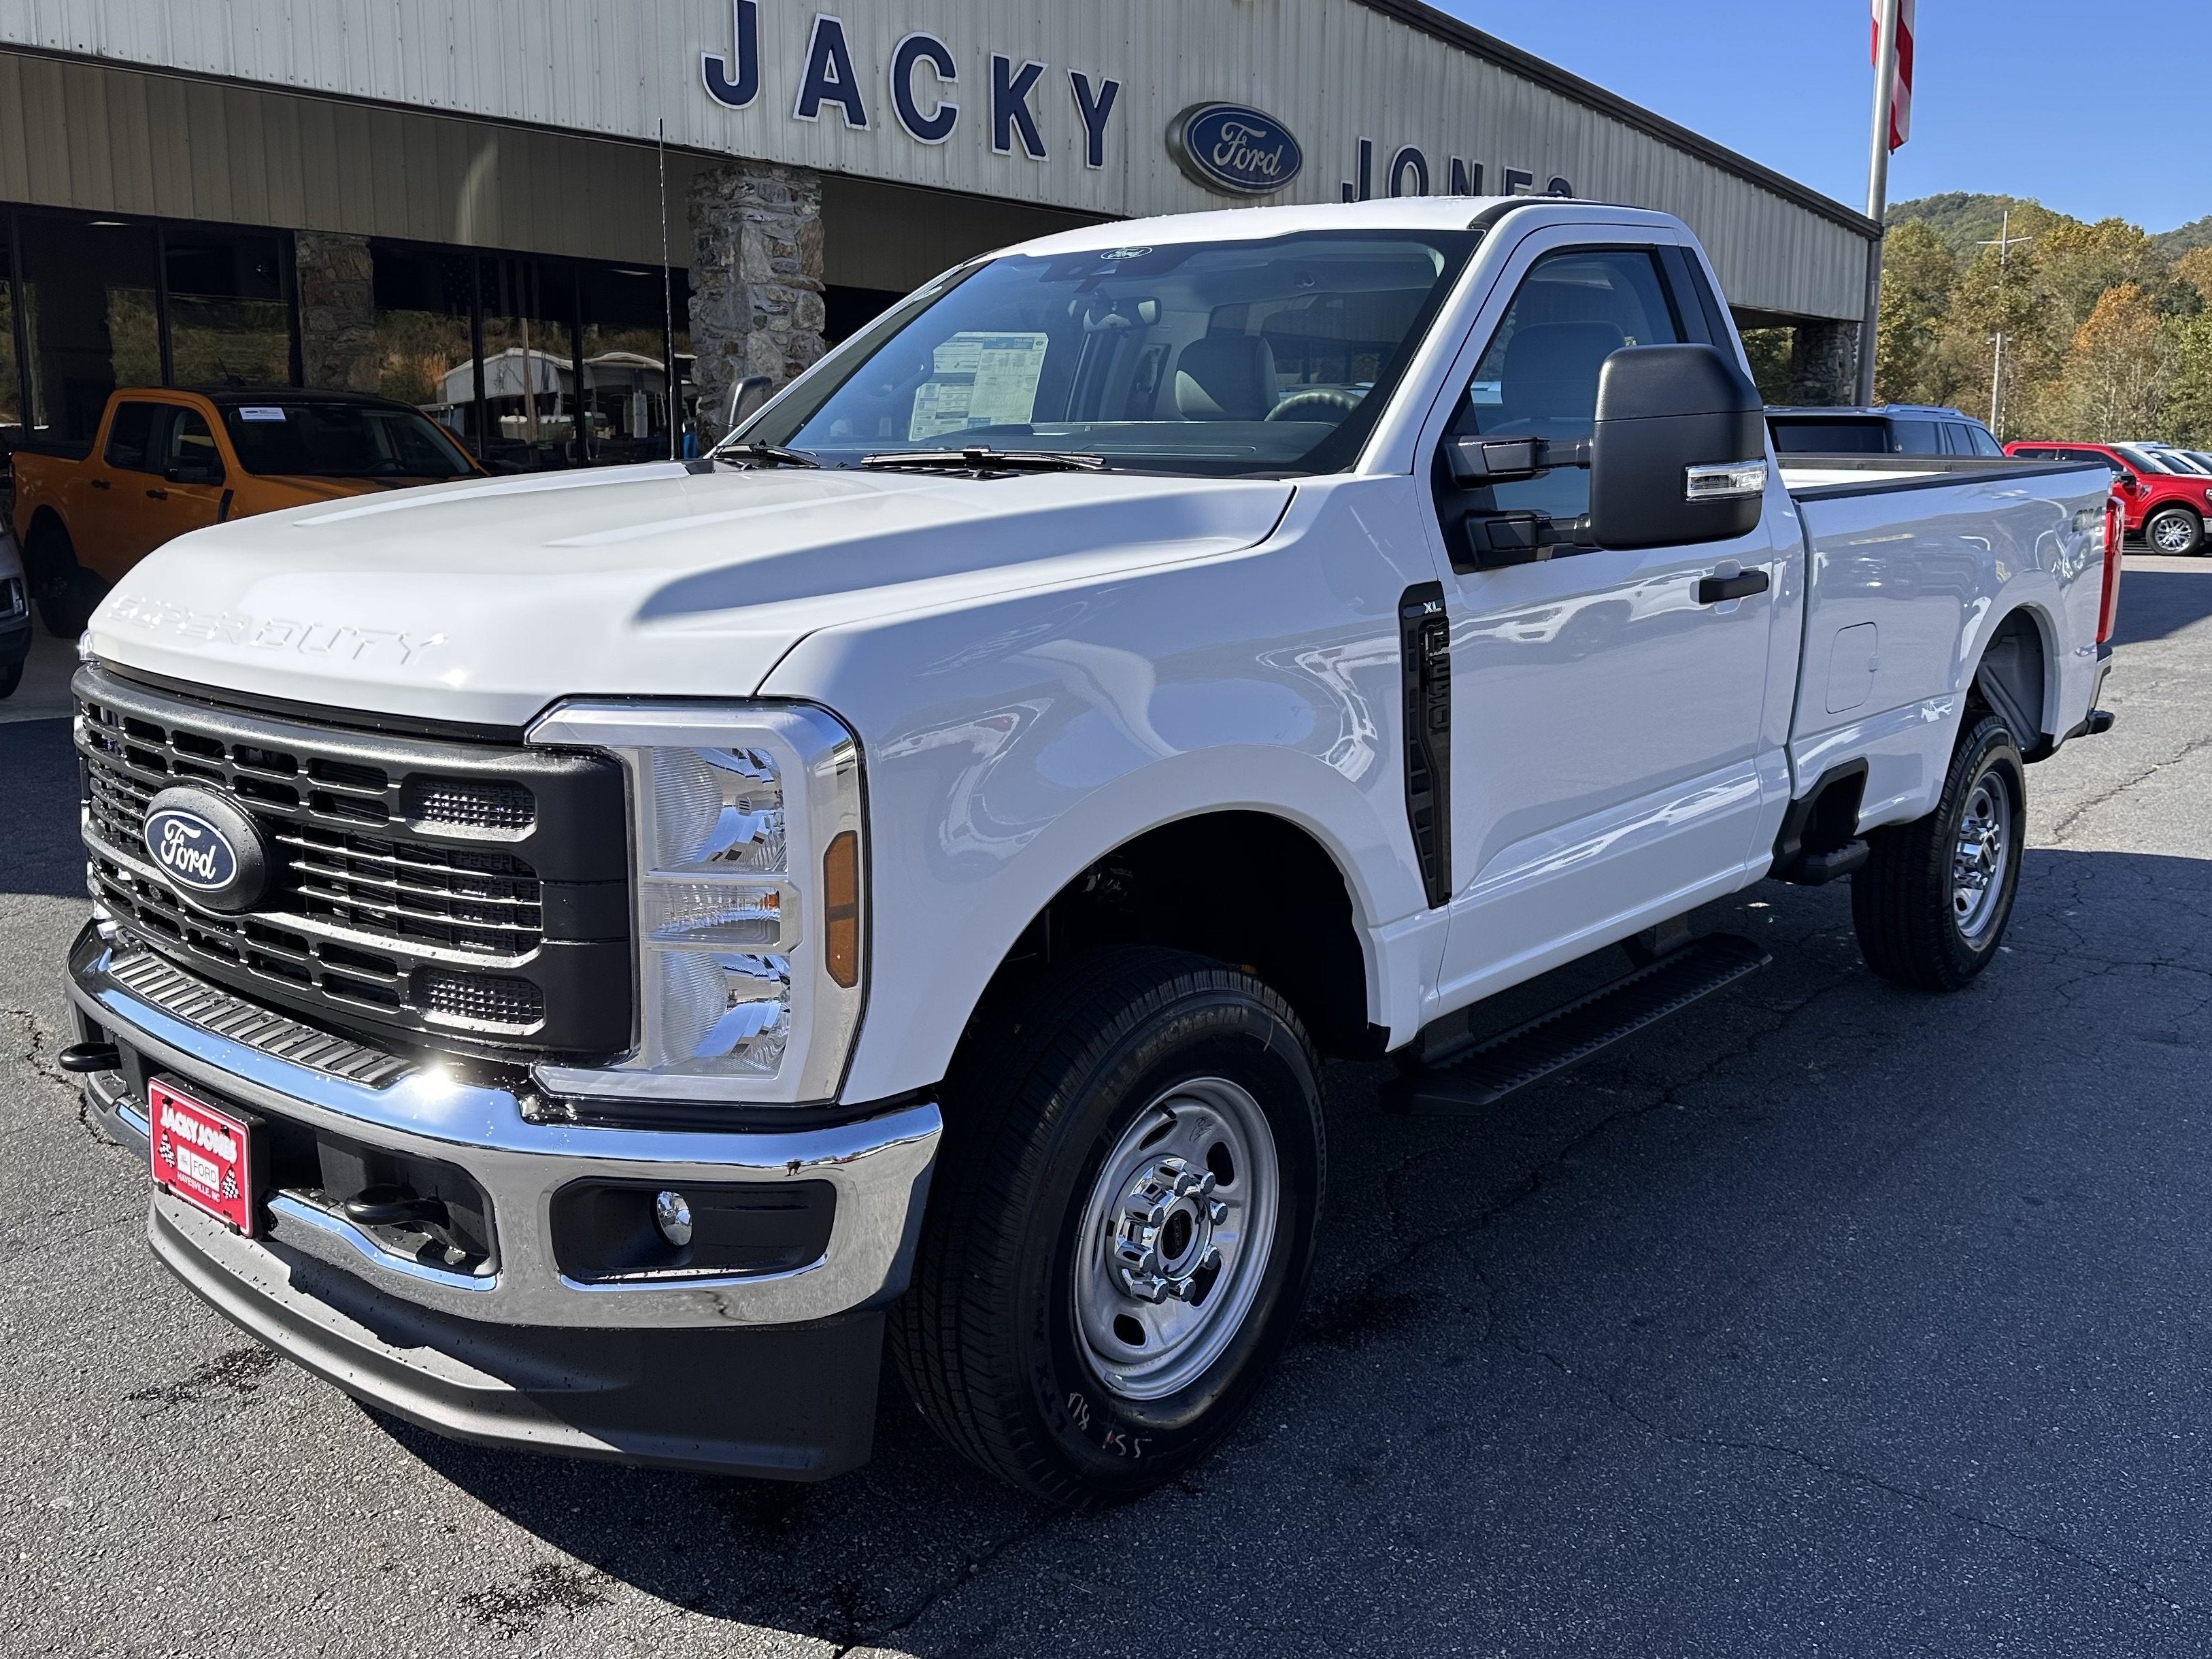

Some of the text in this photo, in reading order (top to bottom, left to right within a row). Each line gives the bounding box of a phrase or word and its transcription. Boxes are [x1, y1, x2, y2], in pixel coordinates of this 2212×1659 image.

[701, 0, 1122, 169] JACKY
[1213, 121, 1284, 176] Ford
[1422, 601, 1442, 614] XL
[250, 616, 450, 665] DUTY
[161, 819, 216, 879] Ford
[160, 1104, 198, 1143] JACKY
[193, 1160, 217, 1184] FORD
